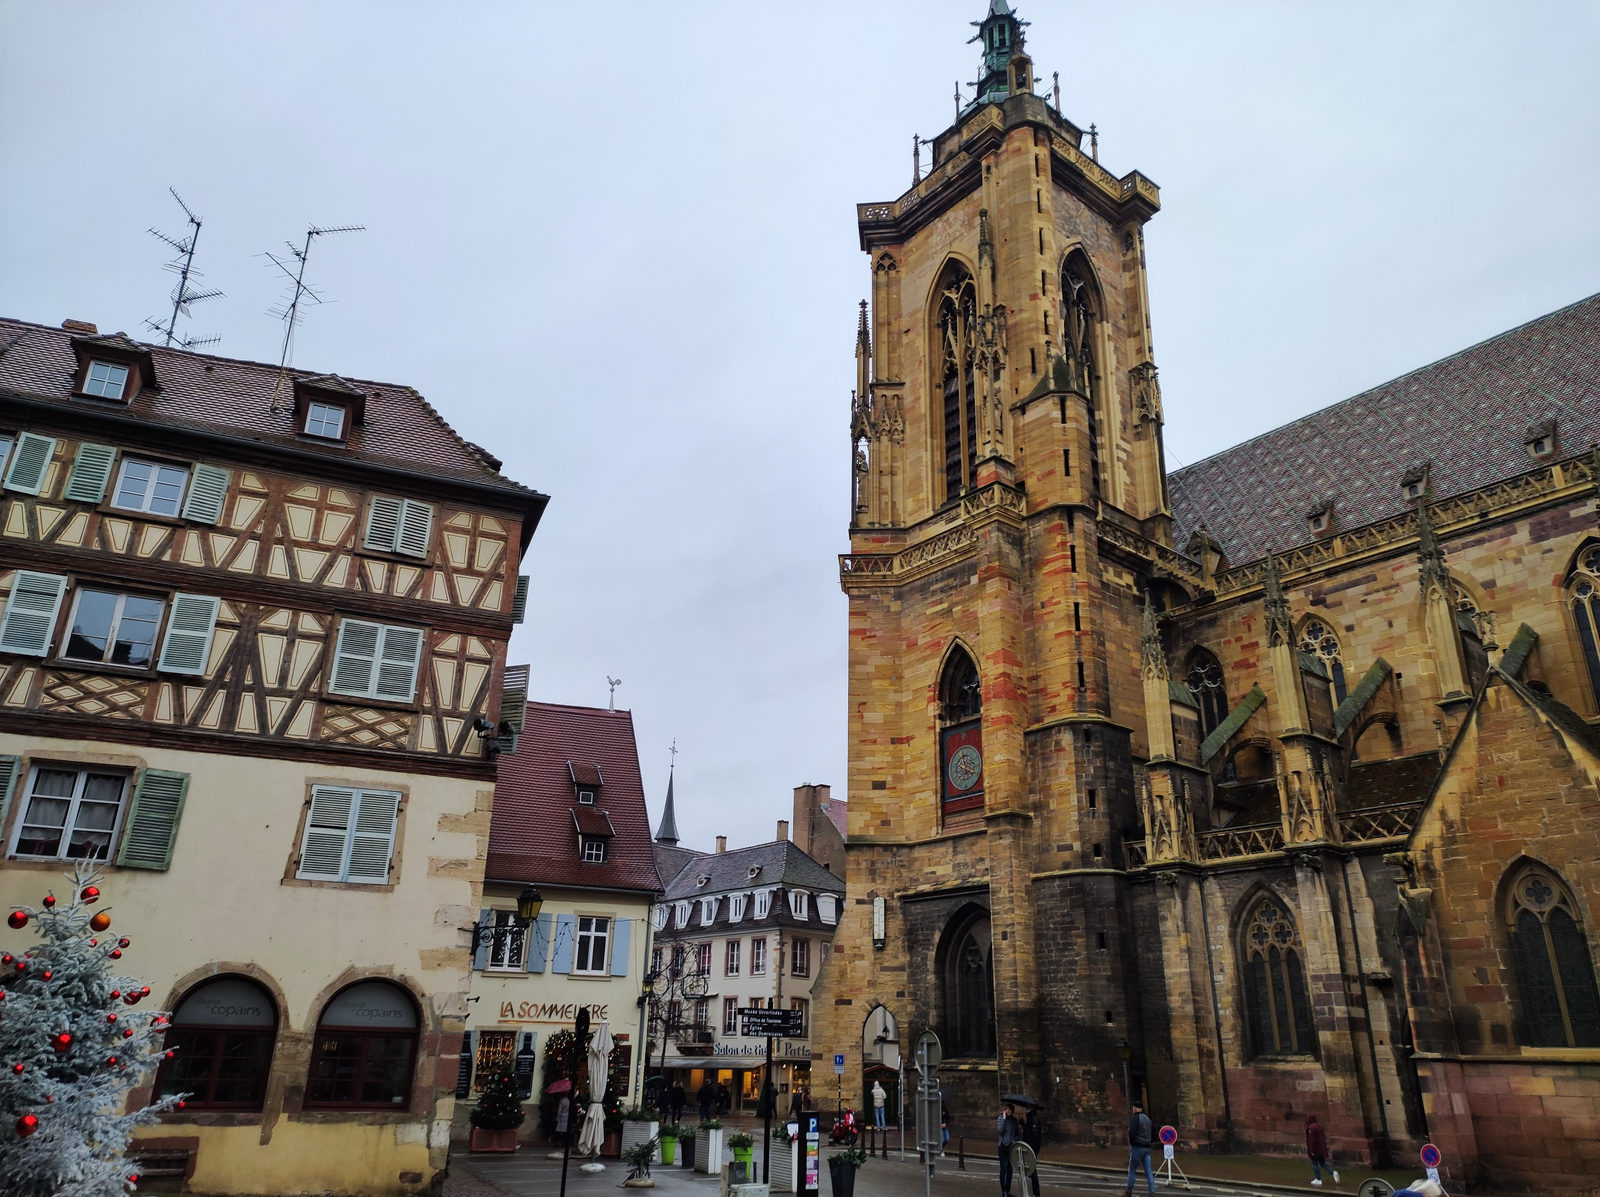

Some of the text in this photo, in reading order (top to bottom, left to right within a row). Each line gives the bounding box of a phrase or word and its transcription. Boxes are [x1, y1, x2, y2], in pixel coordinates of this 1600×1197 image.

[211, 1005, 263, 1018] copains
[355, 1007, 403, 1020] copains
[500, 1000, 609, 1020] LA SOMMELRE
[714, 1042, 738, 1056] Salon
[740, 1044, 752, 1056] de
[809, 1118, 817, 1132] P
